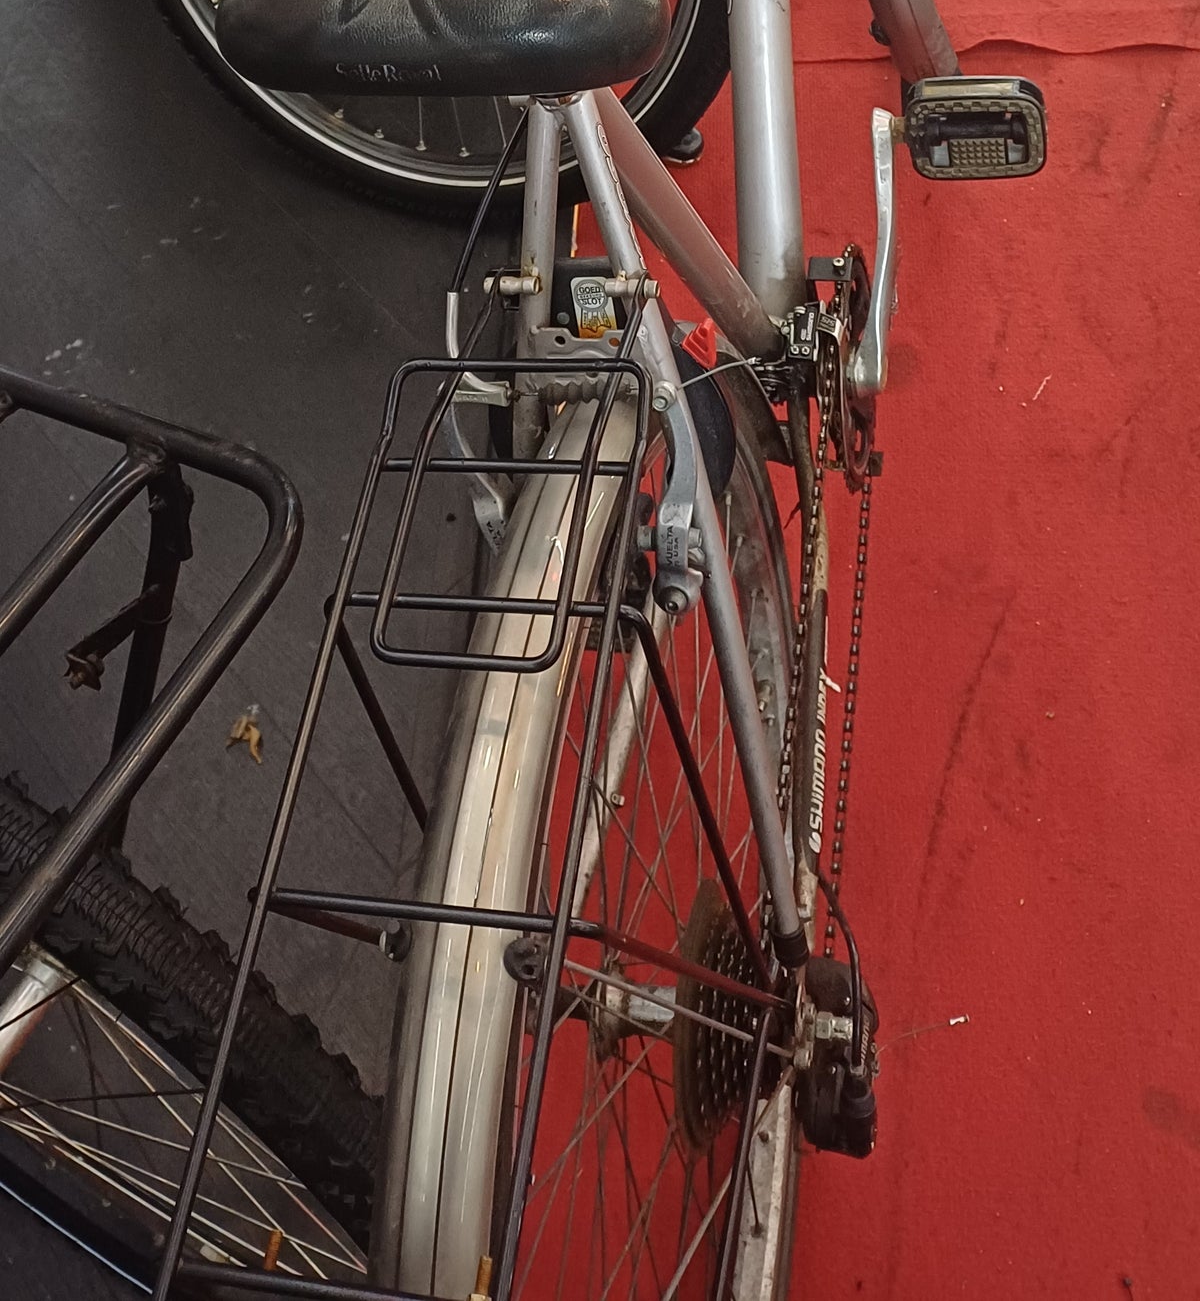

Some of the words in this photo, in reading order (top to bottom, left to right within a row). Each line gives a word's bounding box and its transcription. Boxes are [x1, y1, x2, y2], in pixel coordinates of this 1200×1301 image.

[578, 286, 601, 294] GOED
[665, 525, 674, 566] VUELTA
[808, 728, 827, 835] SHIMANO
